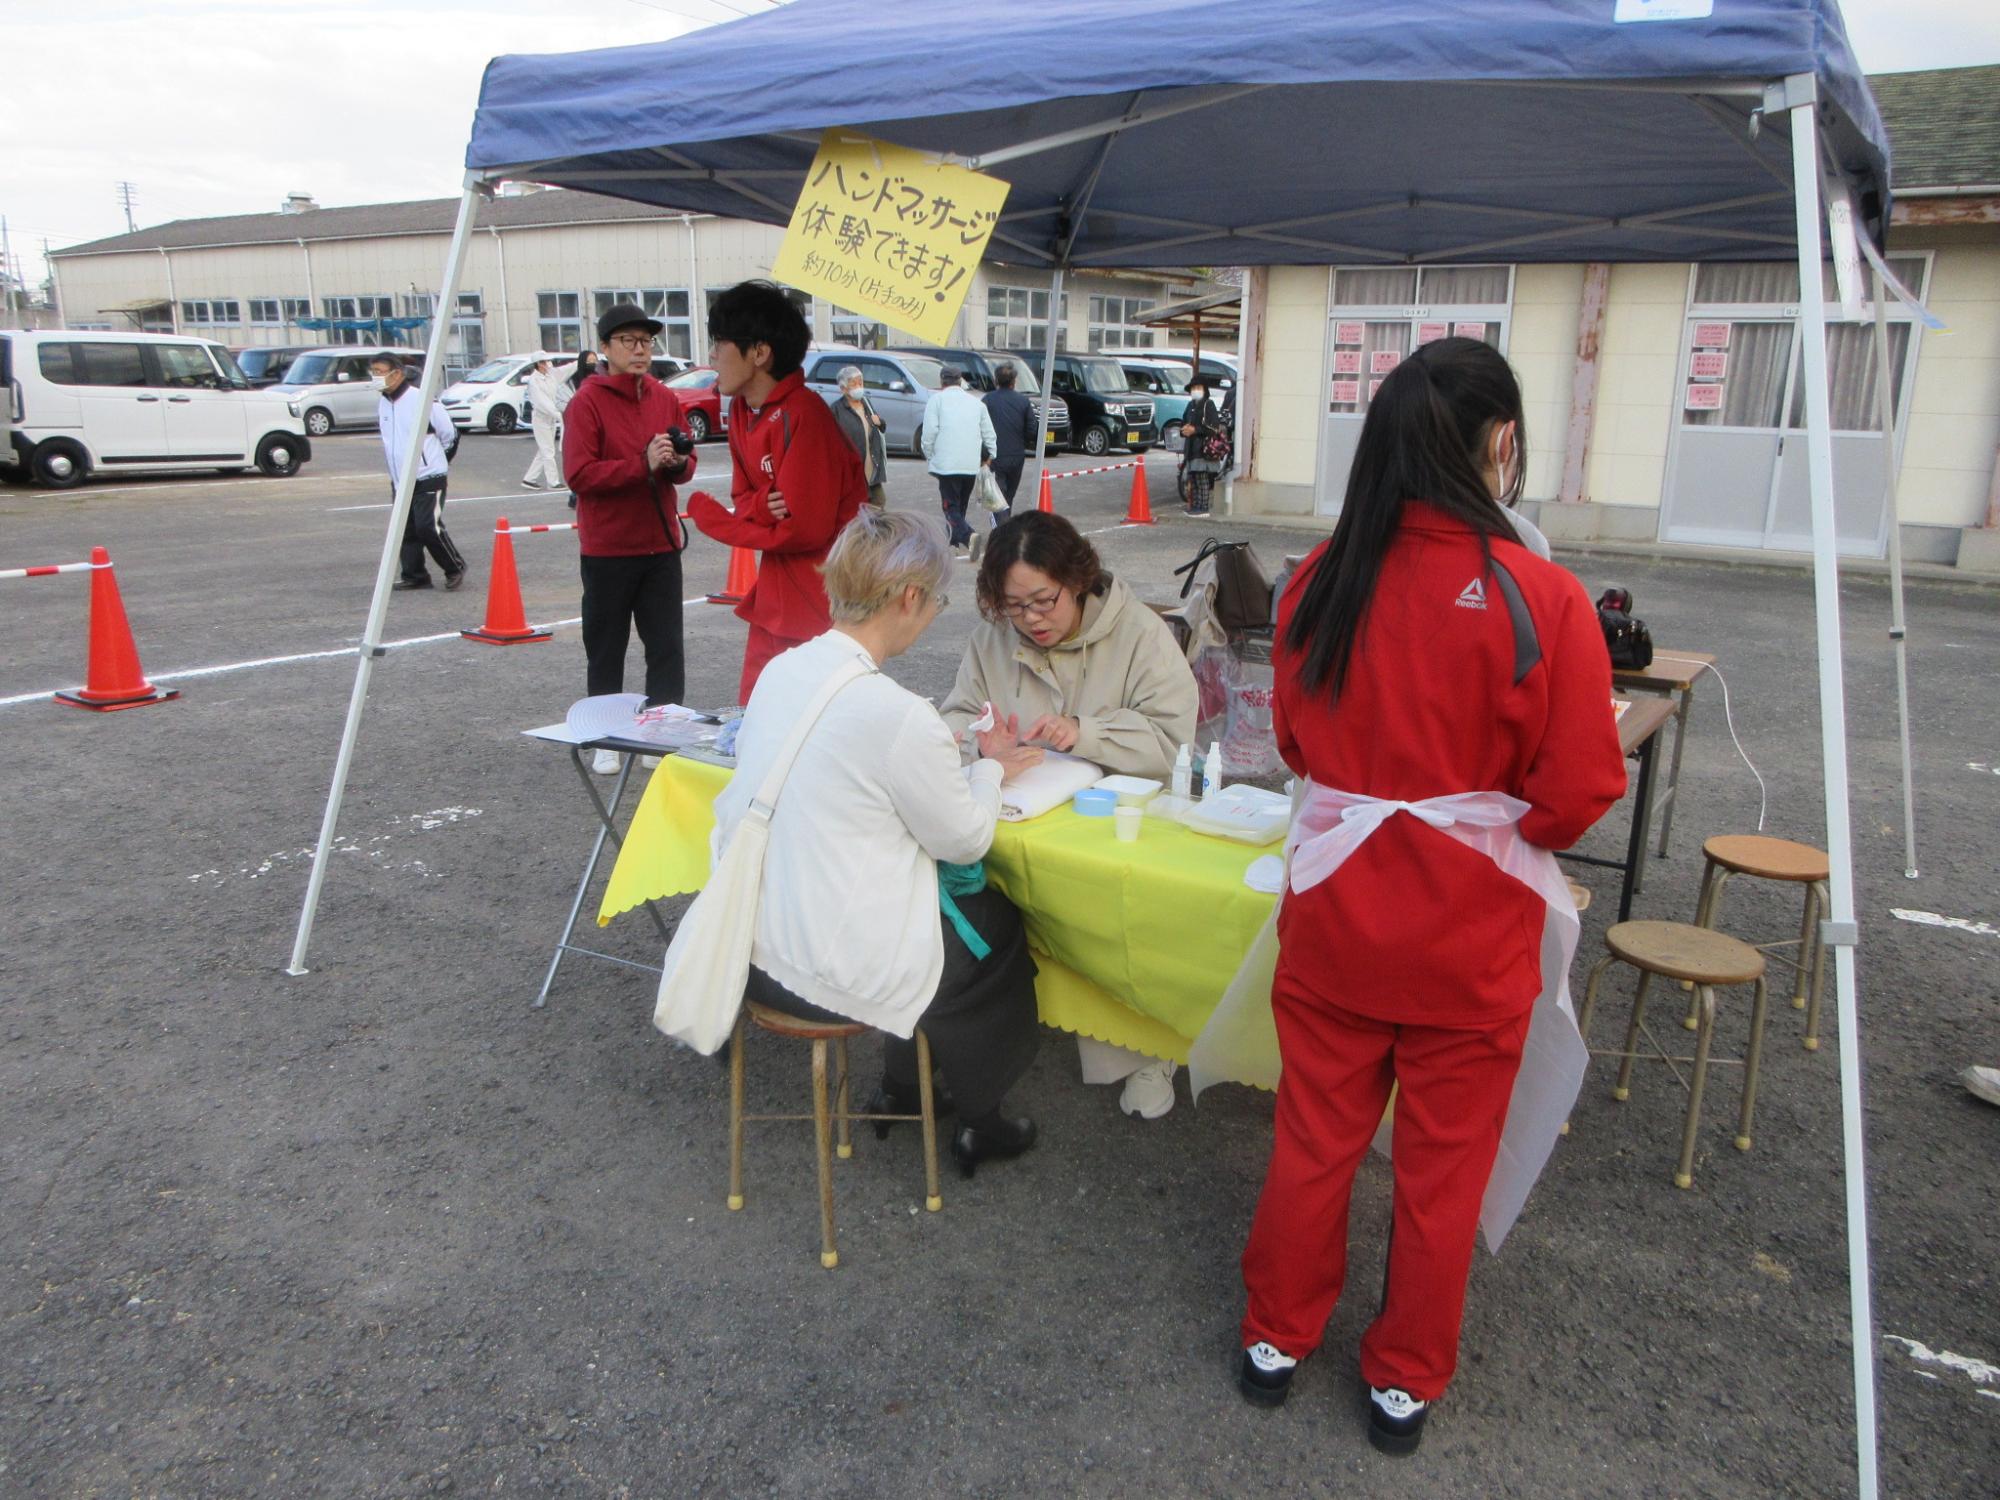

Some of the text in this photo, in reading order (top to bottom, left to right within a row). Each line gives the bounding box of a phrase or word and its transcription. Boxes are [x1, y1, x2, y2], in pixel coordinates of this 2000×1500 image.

[811, 159, 997, 246] ハンドマッサージ
[1454, 598, 1488, 610] Reebok
